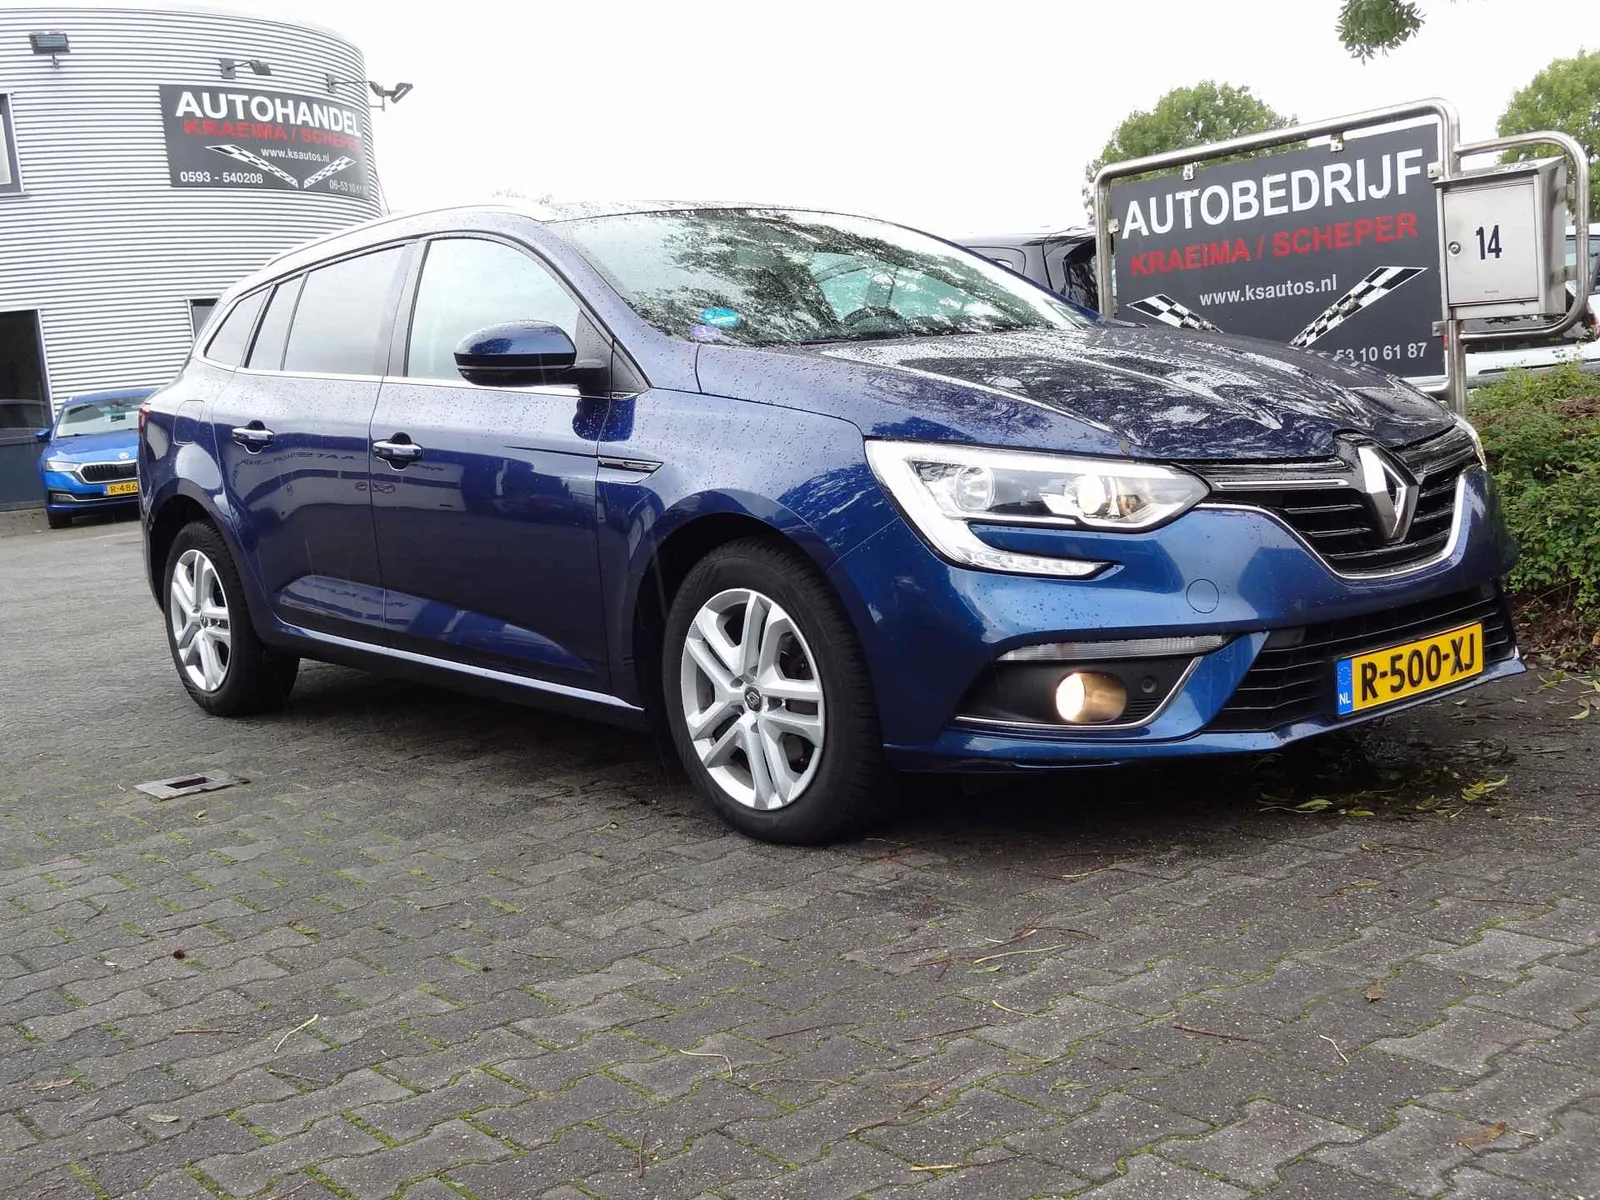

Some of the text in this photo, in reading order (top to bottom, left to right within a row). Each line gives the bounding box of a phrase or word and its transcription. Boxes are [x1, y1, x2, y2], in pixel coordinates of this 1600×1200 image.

[175, 91, 361, 137] AUTOHANDEL
[183, 119, 287, 140] KRAEIMA
[260, 147, 330, 162] www.ksautos.nl
[180, 171, 211, 183] 0593
[222, 172, 264, 184] 540208
[1121, 148, 1424, 240] AUTOBEDRIJF
[1129, 213, 1419, 277] KRAEIMA / SCHEPER
[1475, 224, 1503, 260] 14
[1199, 273, 1338, 307] www.ksautos.nl
[1359, 346, 1378, 362] 10
[1382, 344, 1401, 360] 61
[1407, 341, 1428, 358] 87
[1339, 633, 1475, 705] NL R-500-XJ
